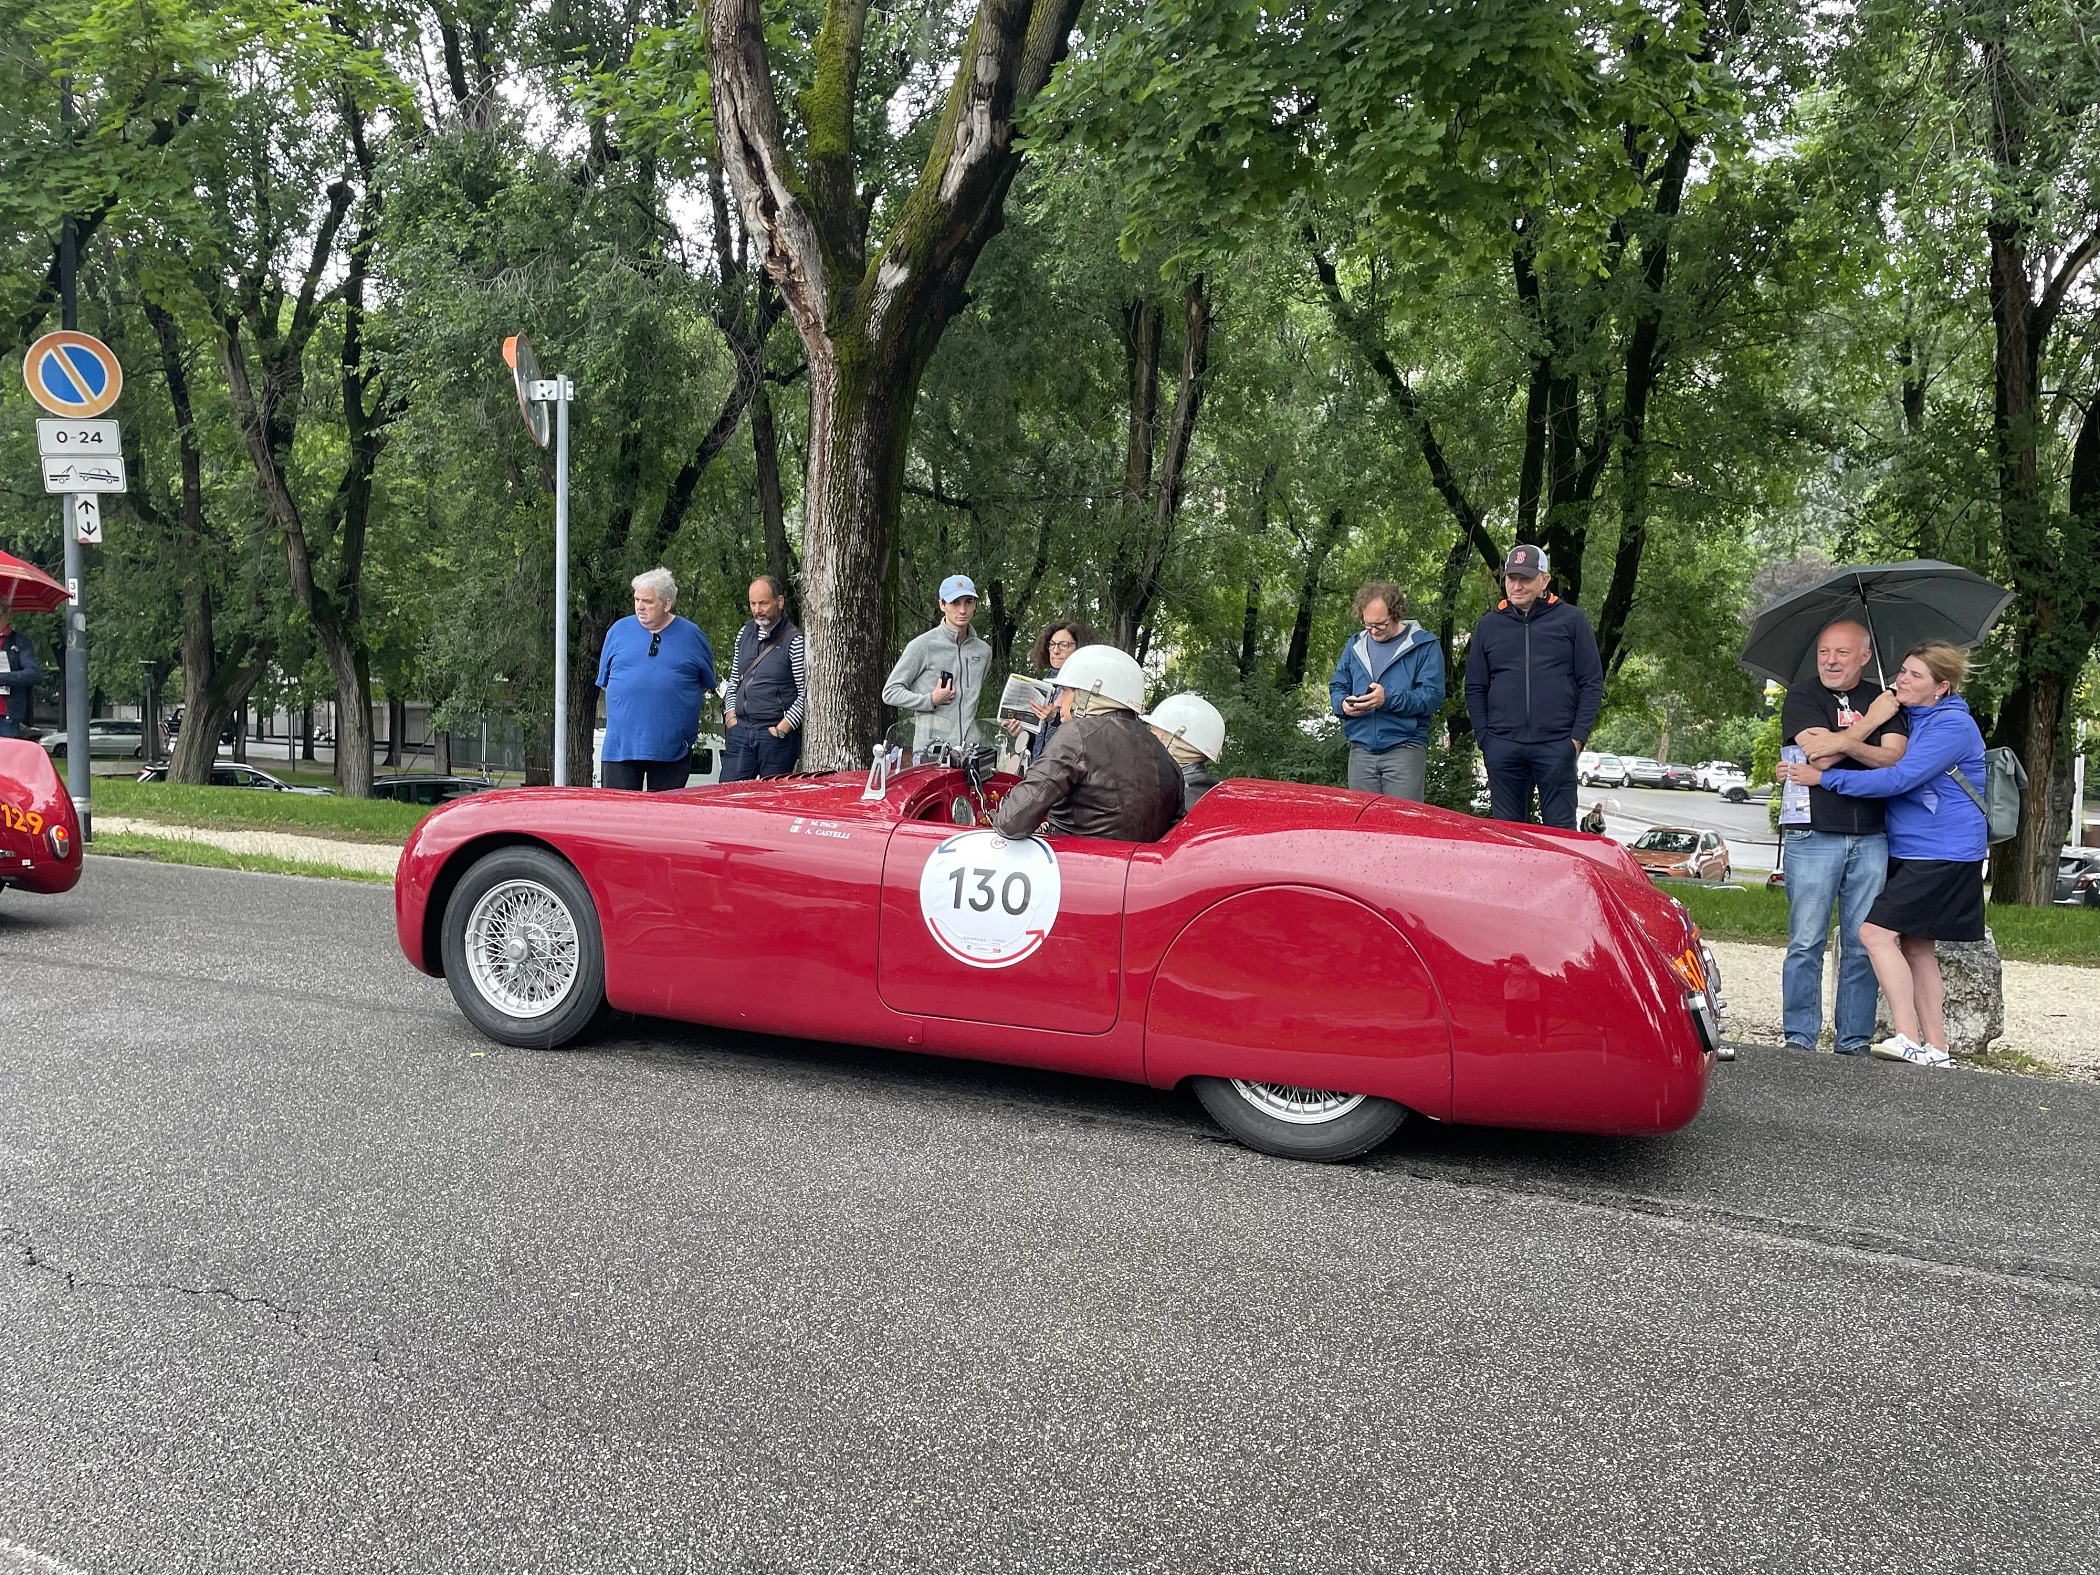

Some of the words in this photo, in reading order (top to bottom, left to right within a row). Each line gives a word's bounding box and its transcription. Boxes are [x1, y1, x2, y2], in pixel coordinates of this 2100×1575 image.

[56, 431, 103, 444] 0-24
[1514, 551, 1526, 564] B
[1, 804, 43, 835] 129
[815, 829, 851, 839] CASTELLI
[949, 867, 1031, 916] 130
